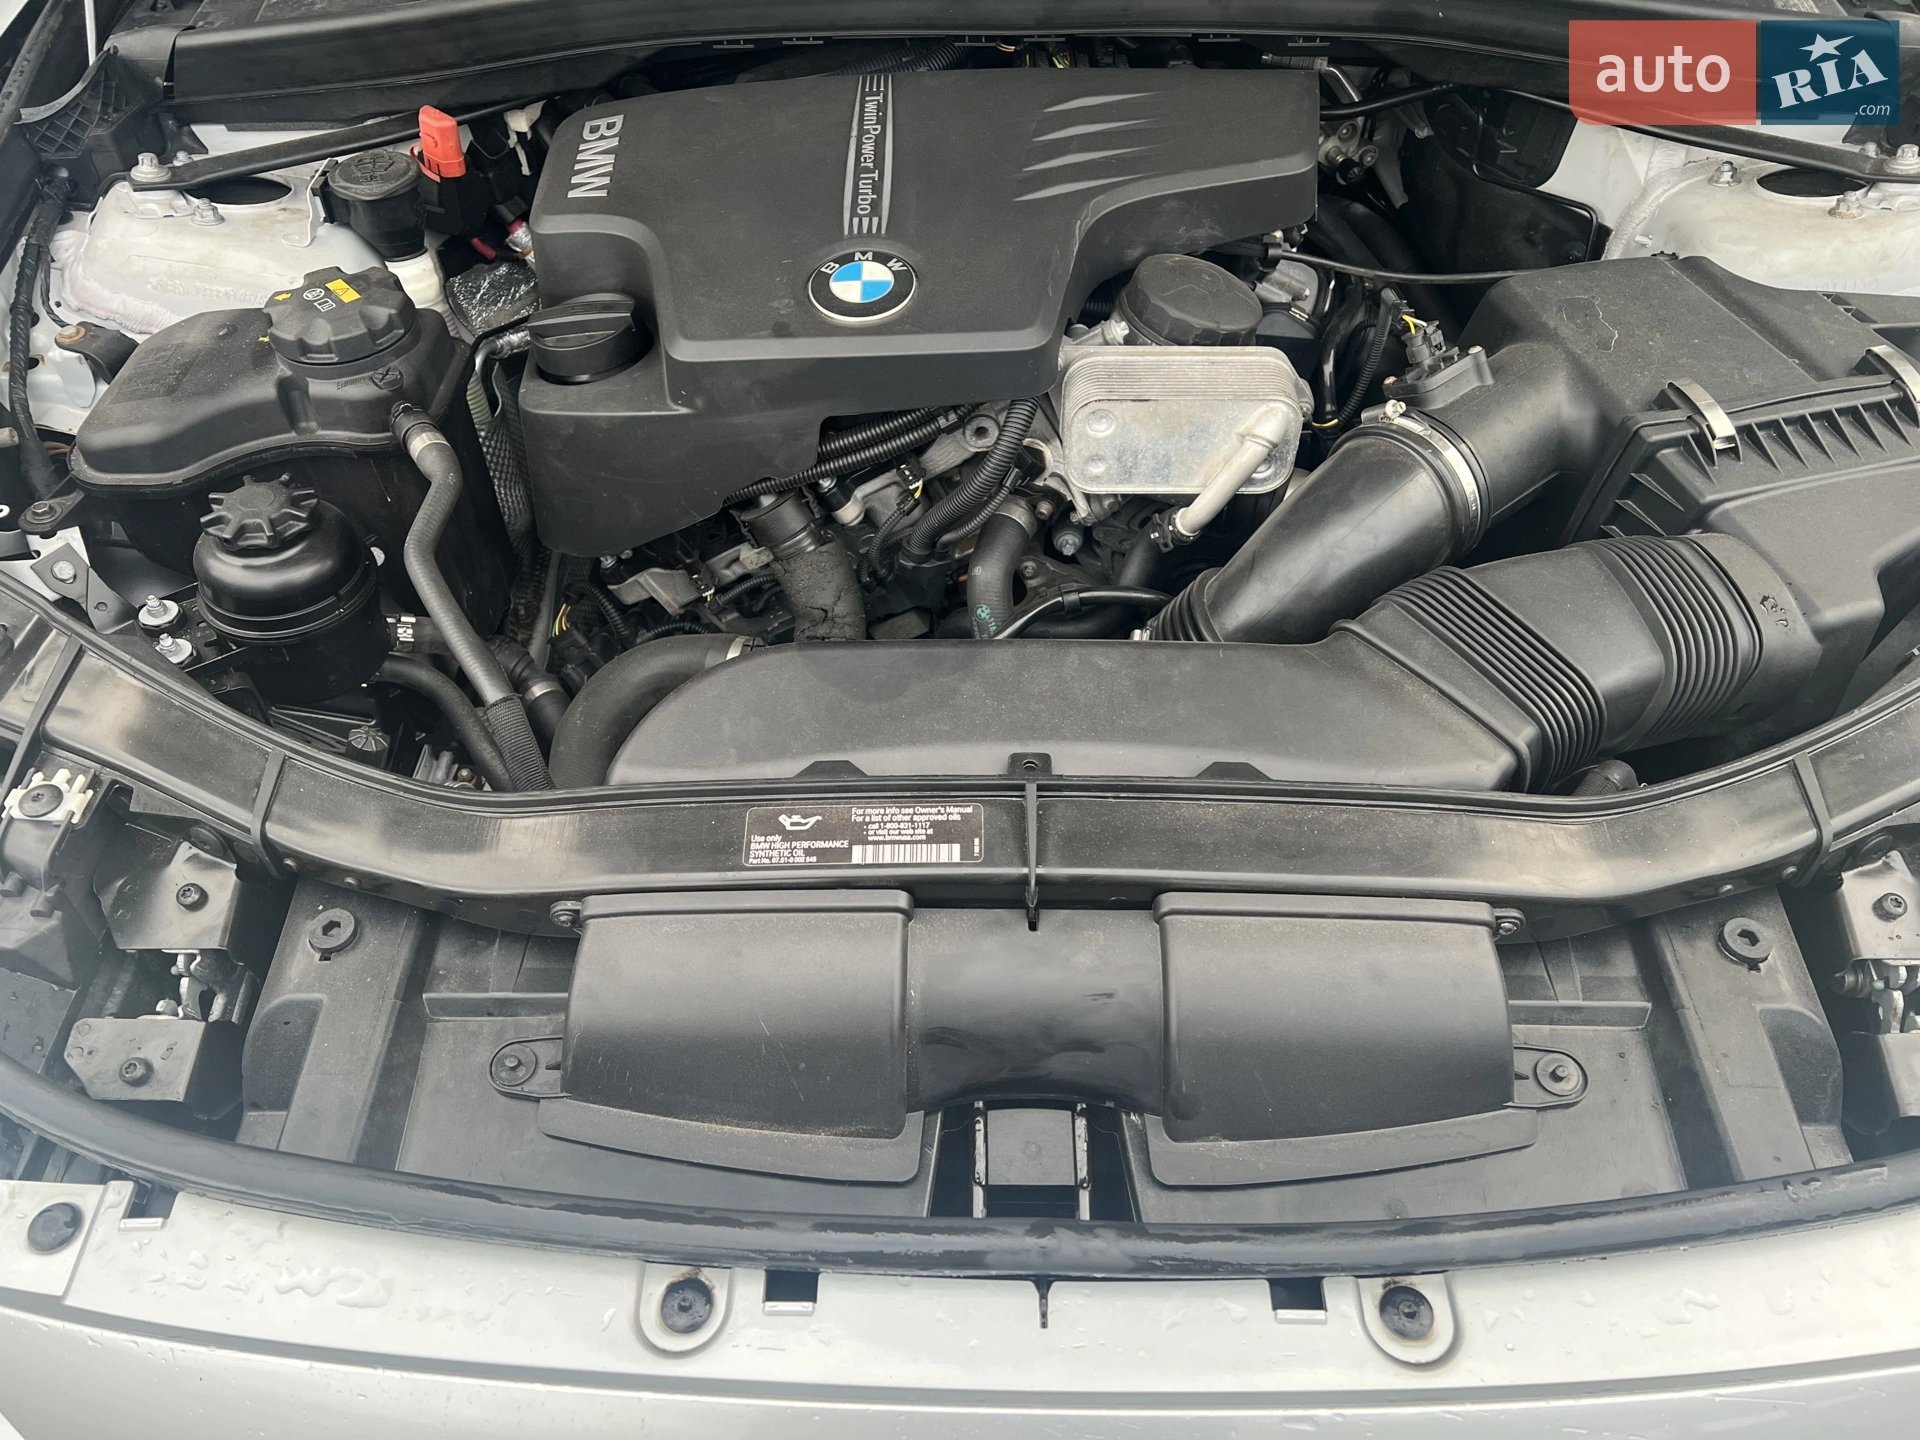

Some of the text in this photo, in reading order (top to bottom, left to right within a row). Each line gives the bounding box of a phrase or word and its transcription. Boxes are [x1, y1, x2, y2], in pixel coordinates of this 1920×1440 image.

[567, 114, 625, 199] BMW
[856, 91, 885, 215] TwinPower Turbo
[820, 251, 908, 275] BMW
[852, 807, 864, 815] For
[885, 806, 900, 814] info
[915, 806, 945, 814] Owner's
[946, 805, 973, 813] Manual
[913, 814, 947, 822] approved
[766, 834, 782, 844] only
[750, 840, 849, 850] BMW HIGH PERFORMANCE
[749, 849, 806, 858] SYNTHETIC OIL
